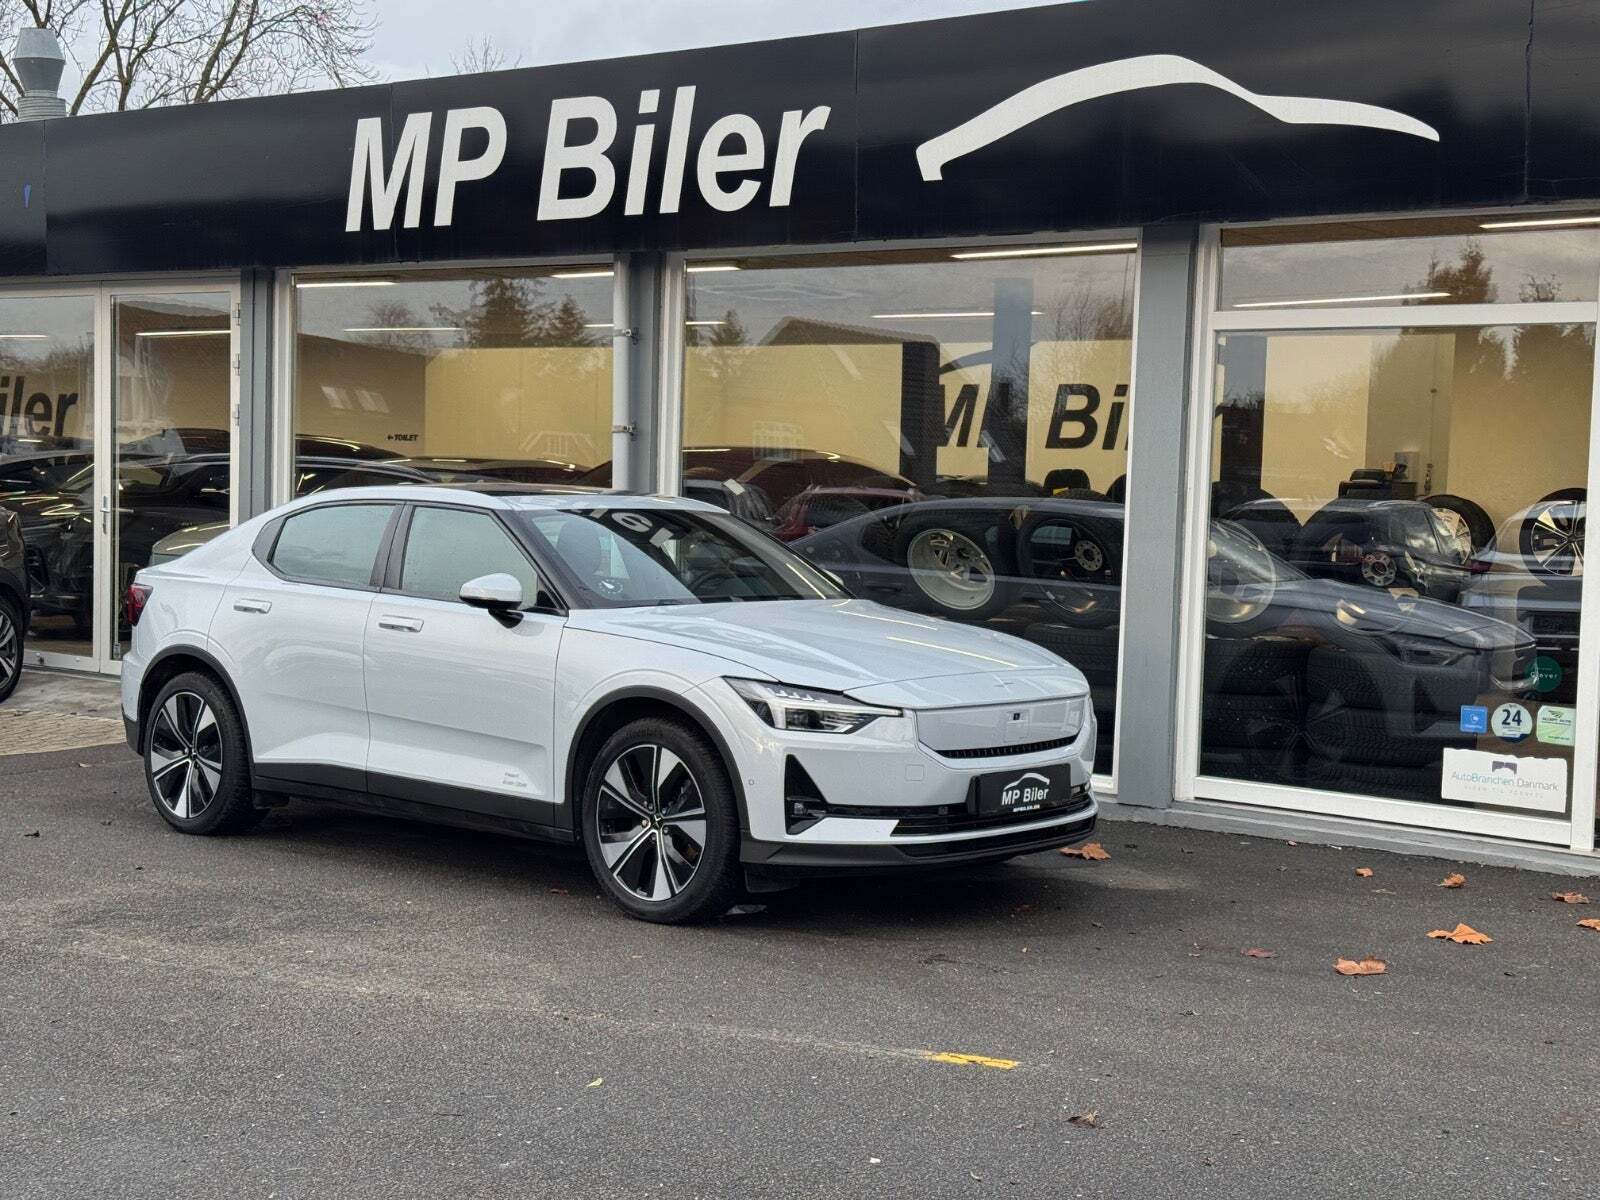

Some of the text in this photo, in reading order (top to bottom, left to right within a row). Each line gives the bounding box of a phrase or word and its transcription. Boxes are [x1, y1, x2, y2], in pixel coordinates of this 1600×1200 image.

[345, 84, 832, 233] MP Biler
[394, 434, 419, 442] TOILET
[1502, 709, 1522, 726] 24
[1516, 777, 1559, 792] Danmark
[1002, 788, 1049, 804] MP Biler
